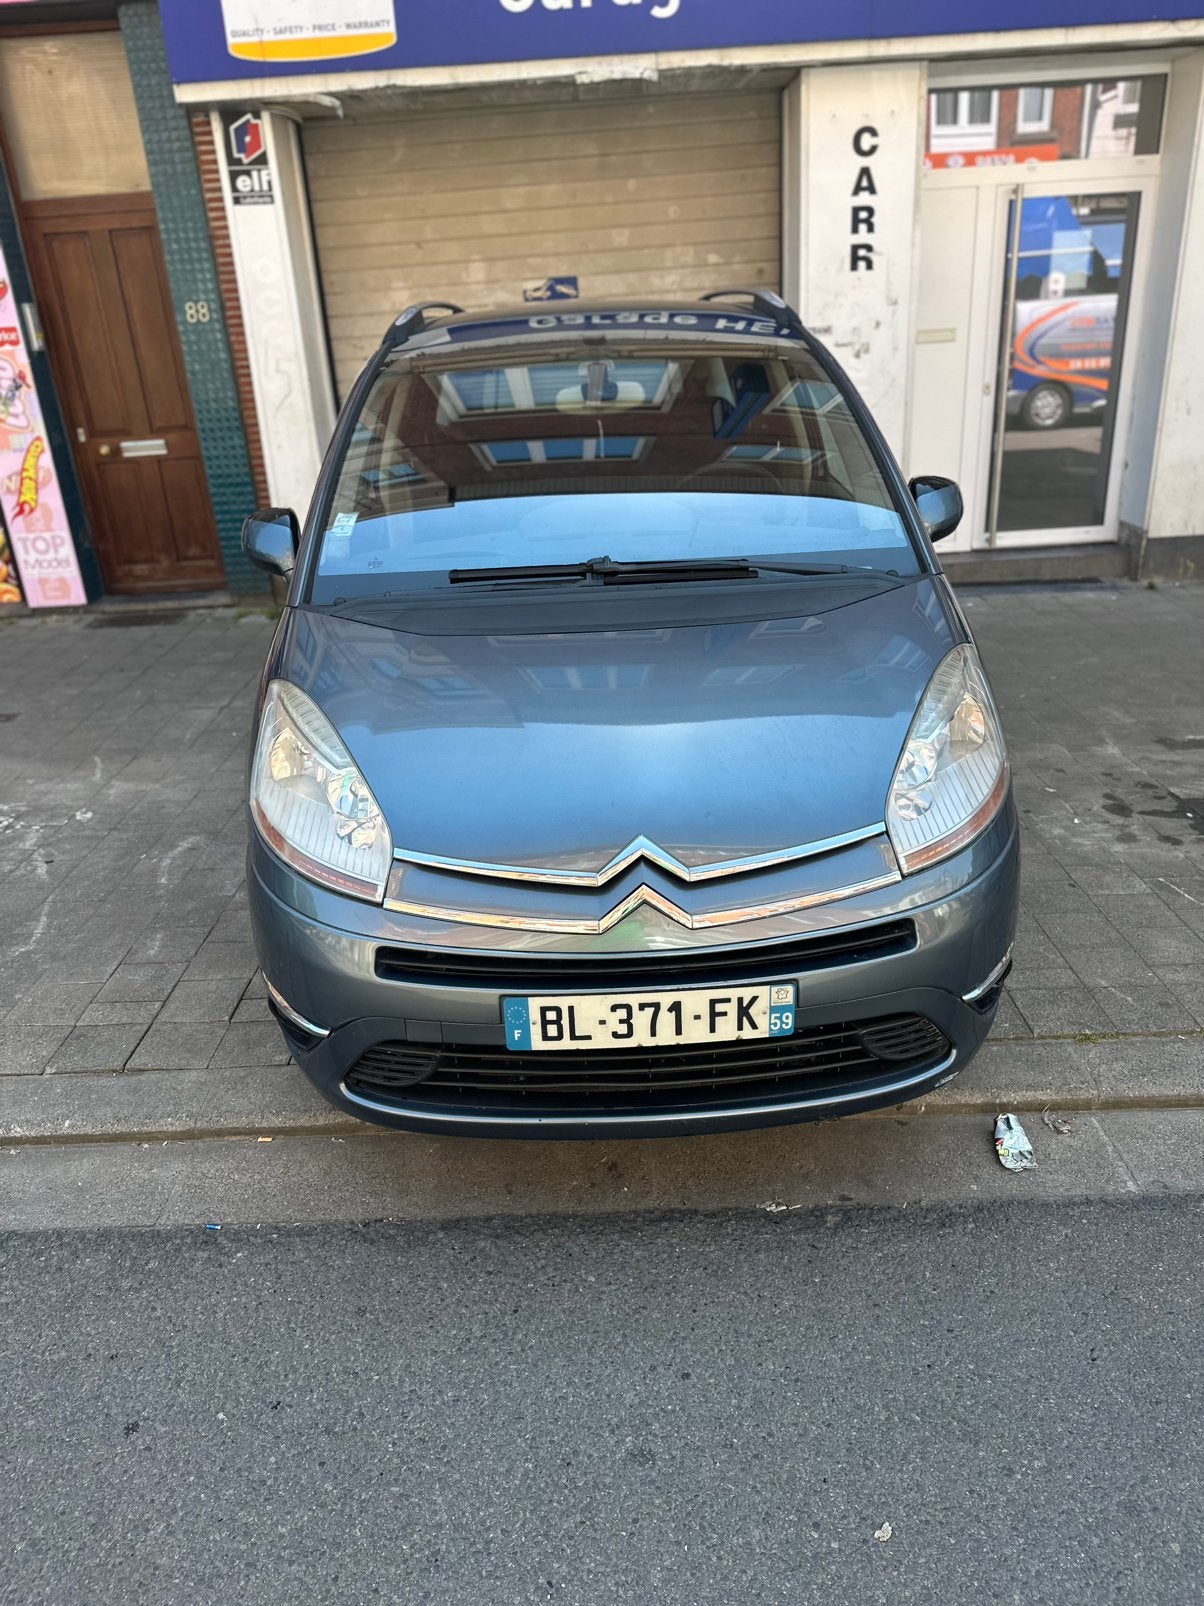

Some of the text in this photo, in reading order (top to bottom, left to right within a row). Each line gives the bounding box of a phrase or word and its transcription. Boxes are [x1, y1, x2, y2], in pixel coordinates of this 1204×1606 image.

[231, 19, 391, 38] QUALITY SAFETY PRICE WARRANTY
[235, 169, 271, 192] elf
[184, 301, 210, 323] 88
[17, 534, 65, 556] TOP
[770, 1012, 793, 1031] 59
[514, 1030, 522, 1040] F
